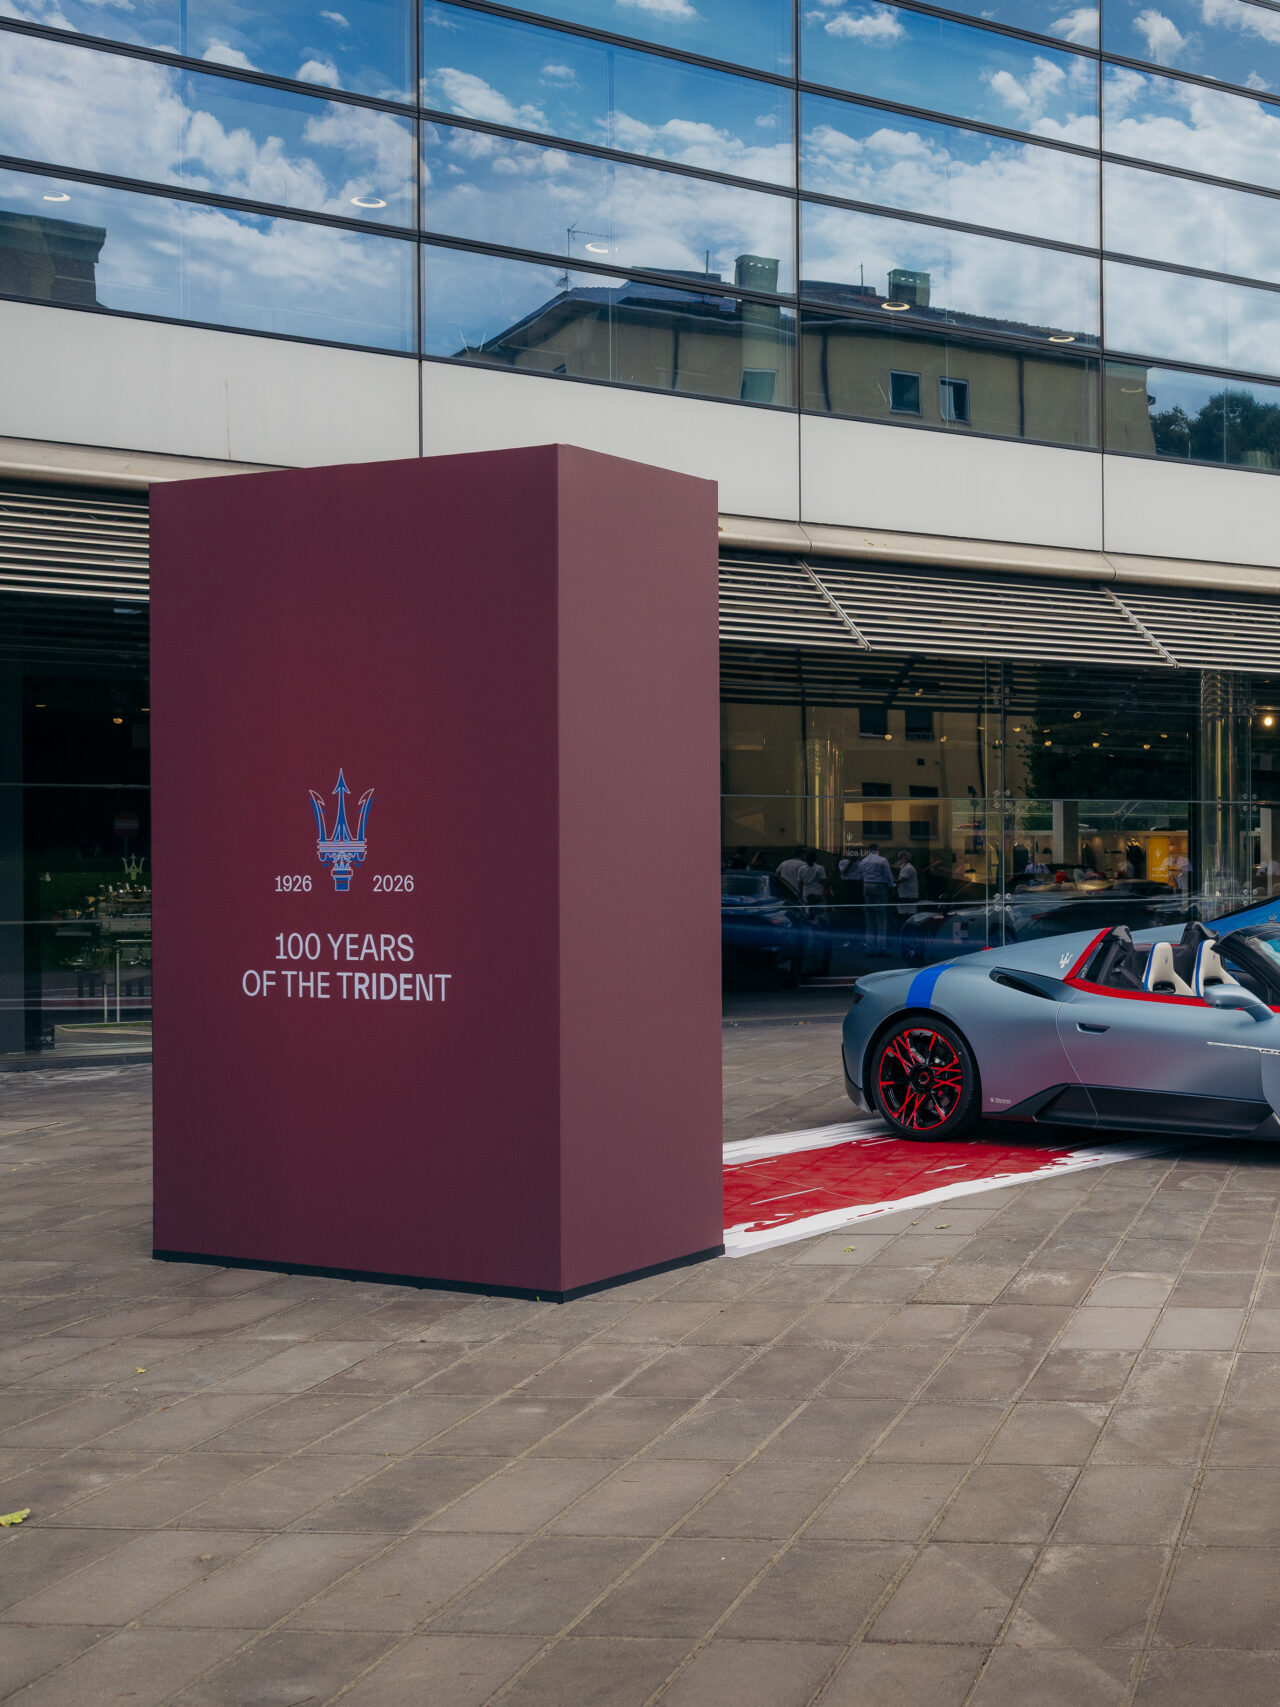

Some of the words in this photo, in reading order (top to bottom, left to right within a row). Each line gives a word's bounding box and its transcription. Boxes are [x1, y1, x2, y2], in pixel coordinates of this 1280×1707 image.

[274, 875, 313, 892] 1926
[372, 875, 415, 892] 2026
[274, 932, 321, 960] 100
[327, 933, 415, 962] YEARS
[242, 969, 276, 997] OF
[281, 970, 330, 999] THE
[336, 971, 452, 1002] TRIDENT
